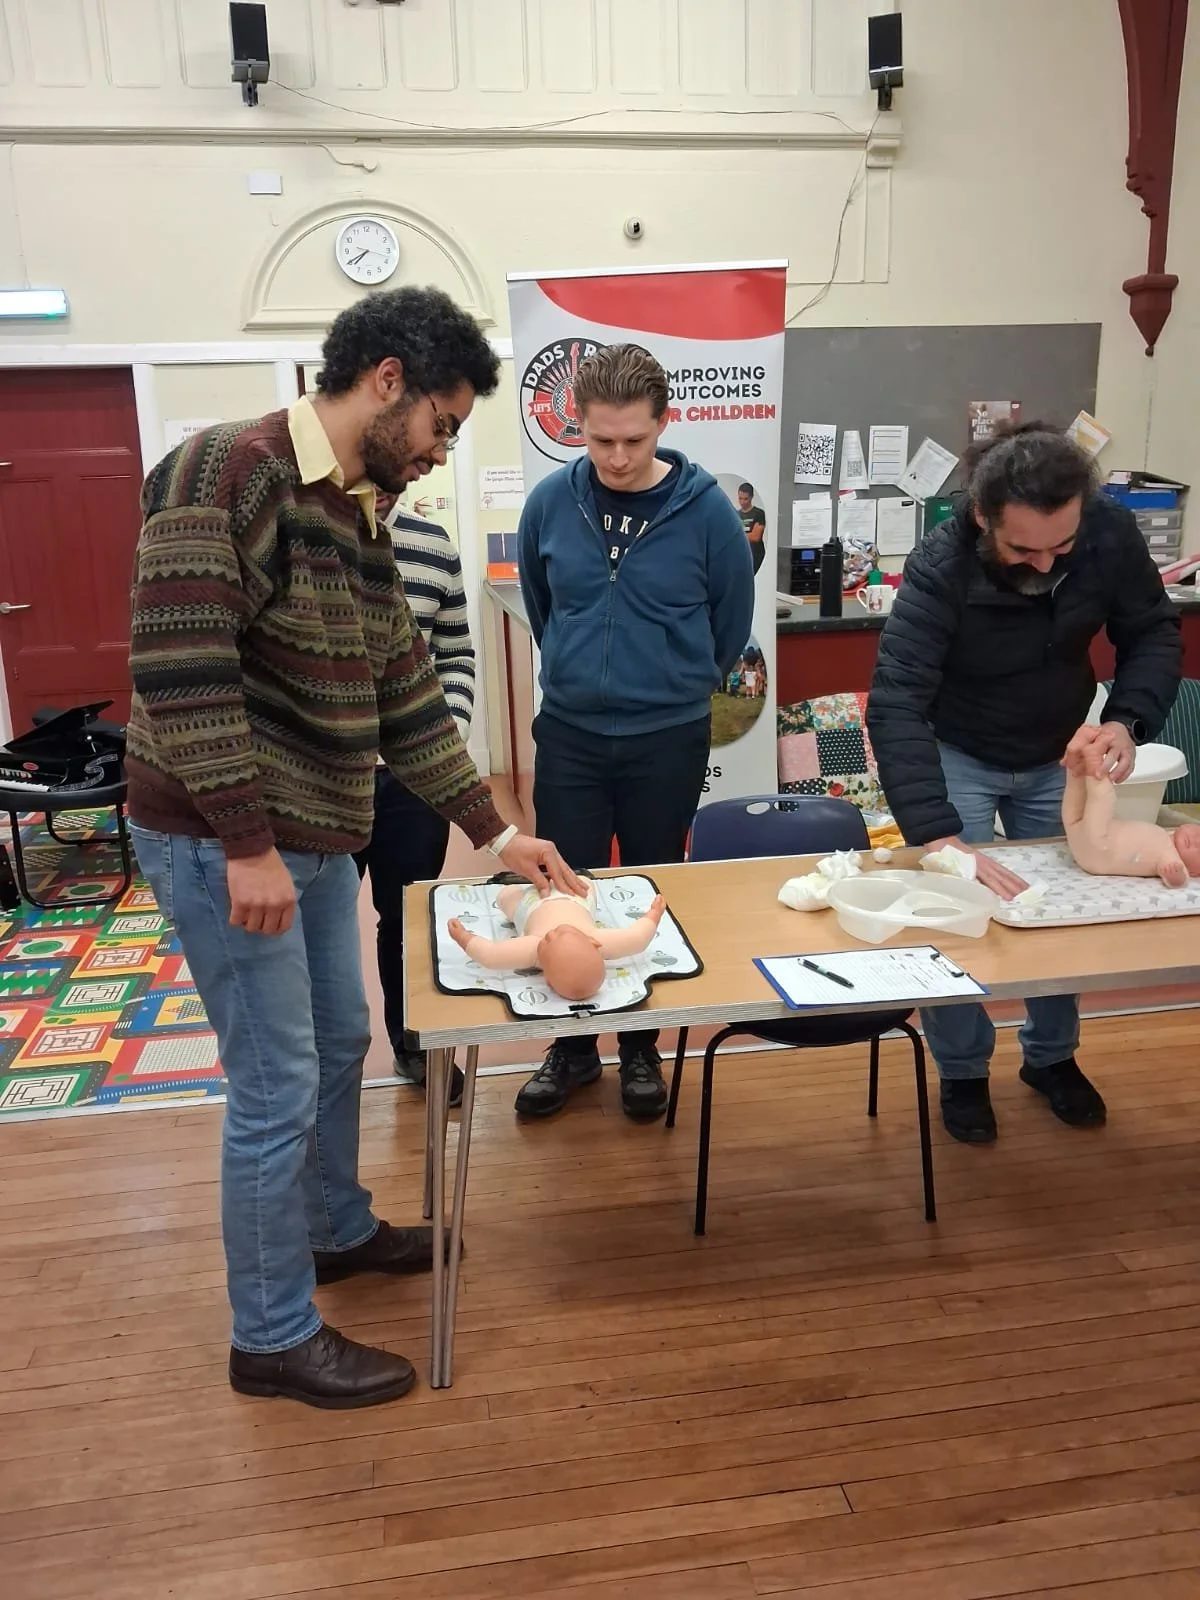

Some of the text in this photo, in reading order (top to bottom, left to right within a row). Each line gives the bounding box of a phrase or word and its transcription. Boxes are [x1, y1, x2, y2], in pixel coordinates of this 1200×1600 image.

[525, 344, 565, 388] DADS
[666, 366, 766, 384] MPROVING
[533, 402, 552, 414] LET'S
[686, 404, 776, 422] CHILDREN
